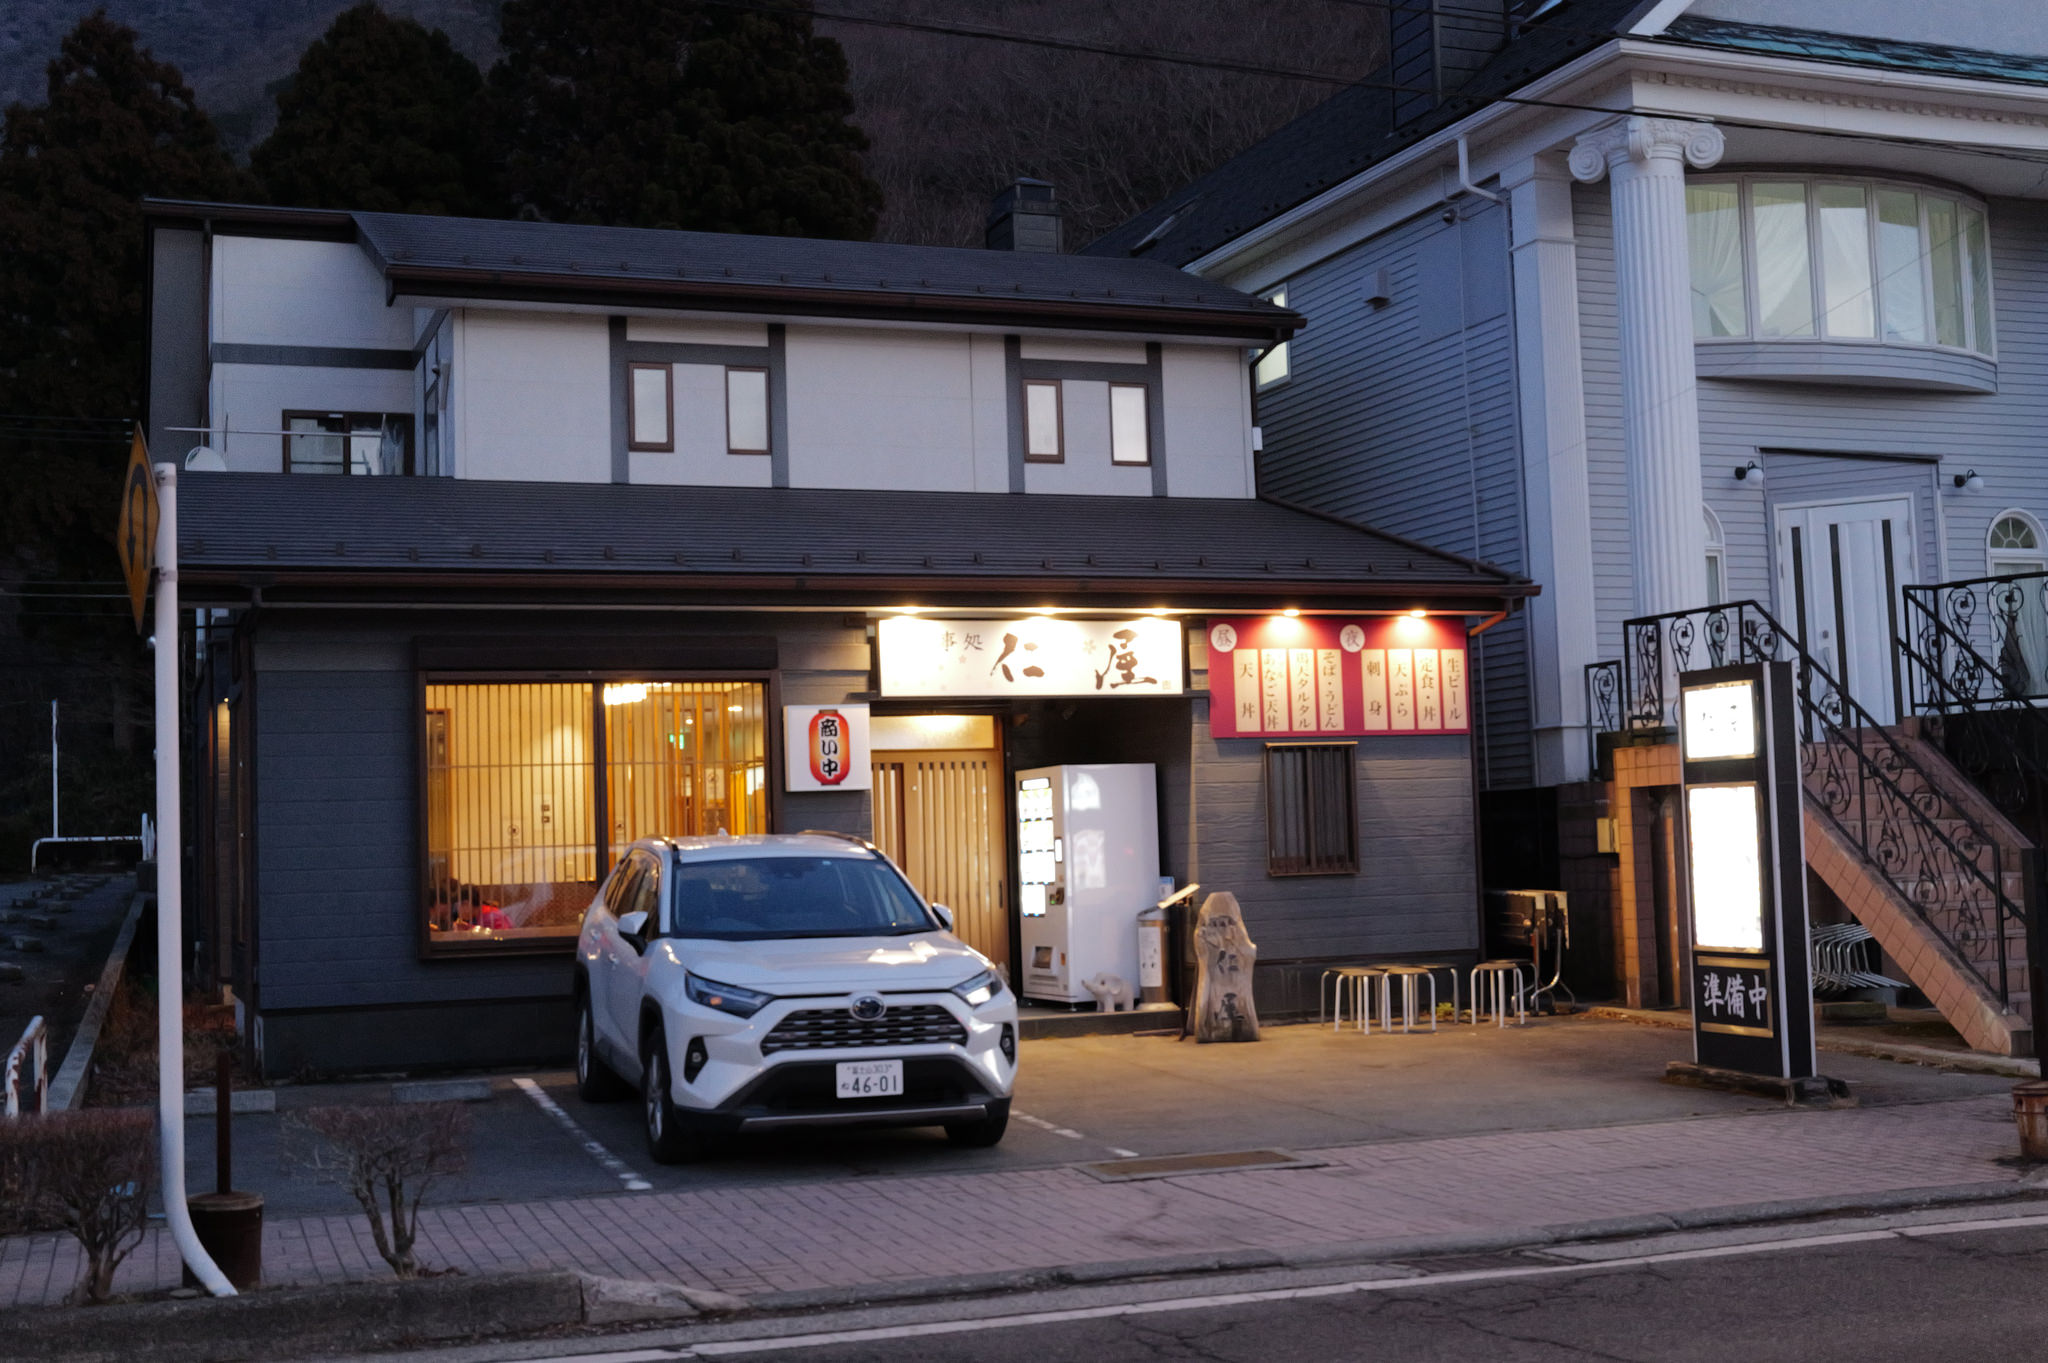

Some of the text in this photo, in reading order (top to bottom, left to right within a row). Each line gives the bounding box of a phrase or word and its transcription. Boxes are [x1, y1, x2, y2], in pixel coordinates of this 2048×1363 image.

[1215, 629, 1233, 648] 昼
[1344, 629, 1361, 648] 夜
[1239, 662, 1255, 720] 天丼
[1367, 660, 1383, 717] 刺身
[1447, 657, 1463, 721] 生ビール
[821, 718, 838, 777] 商い中
[1703, 972, 1768, 1020] 準備中
